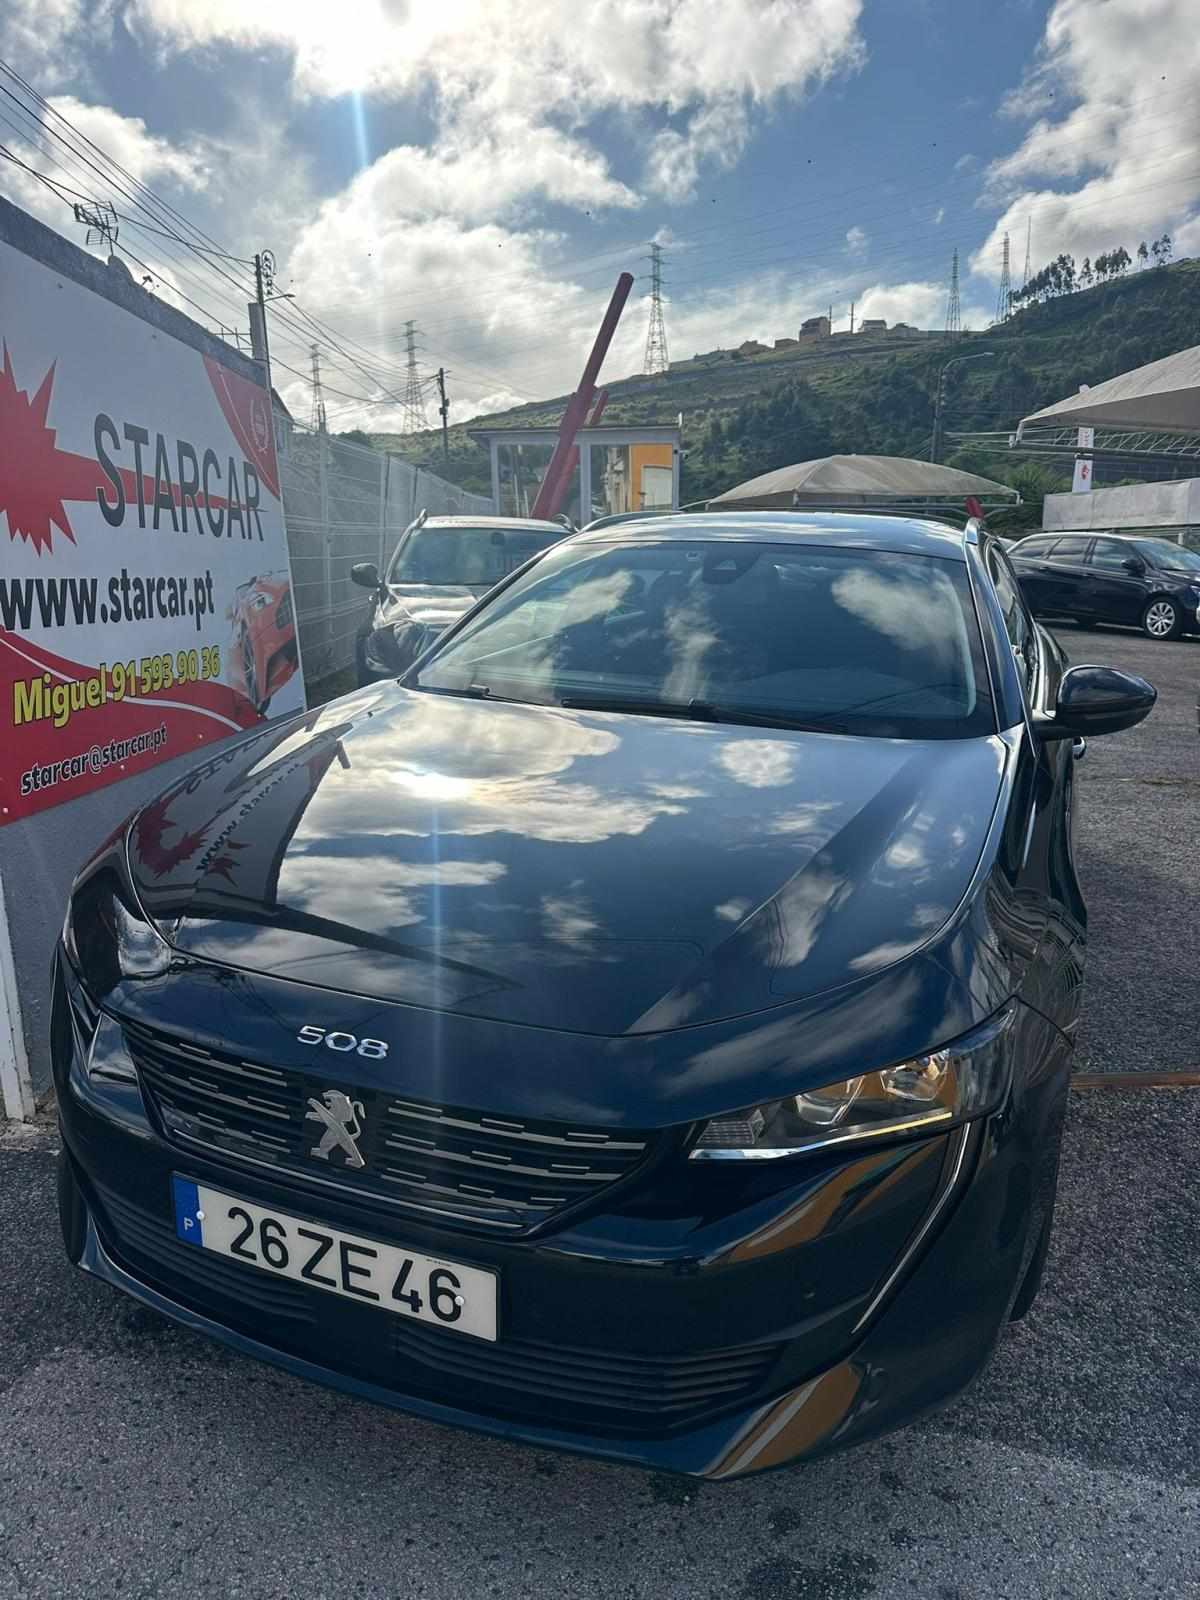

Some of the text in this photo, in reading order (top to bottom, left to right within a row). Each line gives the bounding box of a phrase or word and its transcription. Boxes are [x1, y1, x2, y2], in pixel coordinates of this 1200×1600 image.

[94, 412, 264, 541] STARCAR
[0, 568, 215, 631] www.starcar.pt
[14, 645, 220, 728] Miguel 91 593 90 36
[20, 722, 167, 795] starcar@starcar.pt
[297, 1025, 389, 1060] 508
[183, 1217, 194, 1231] P
[228, 1207, 462, 1323] 26 ZE 46
